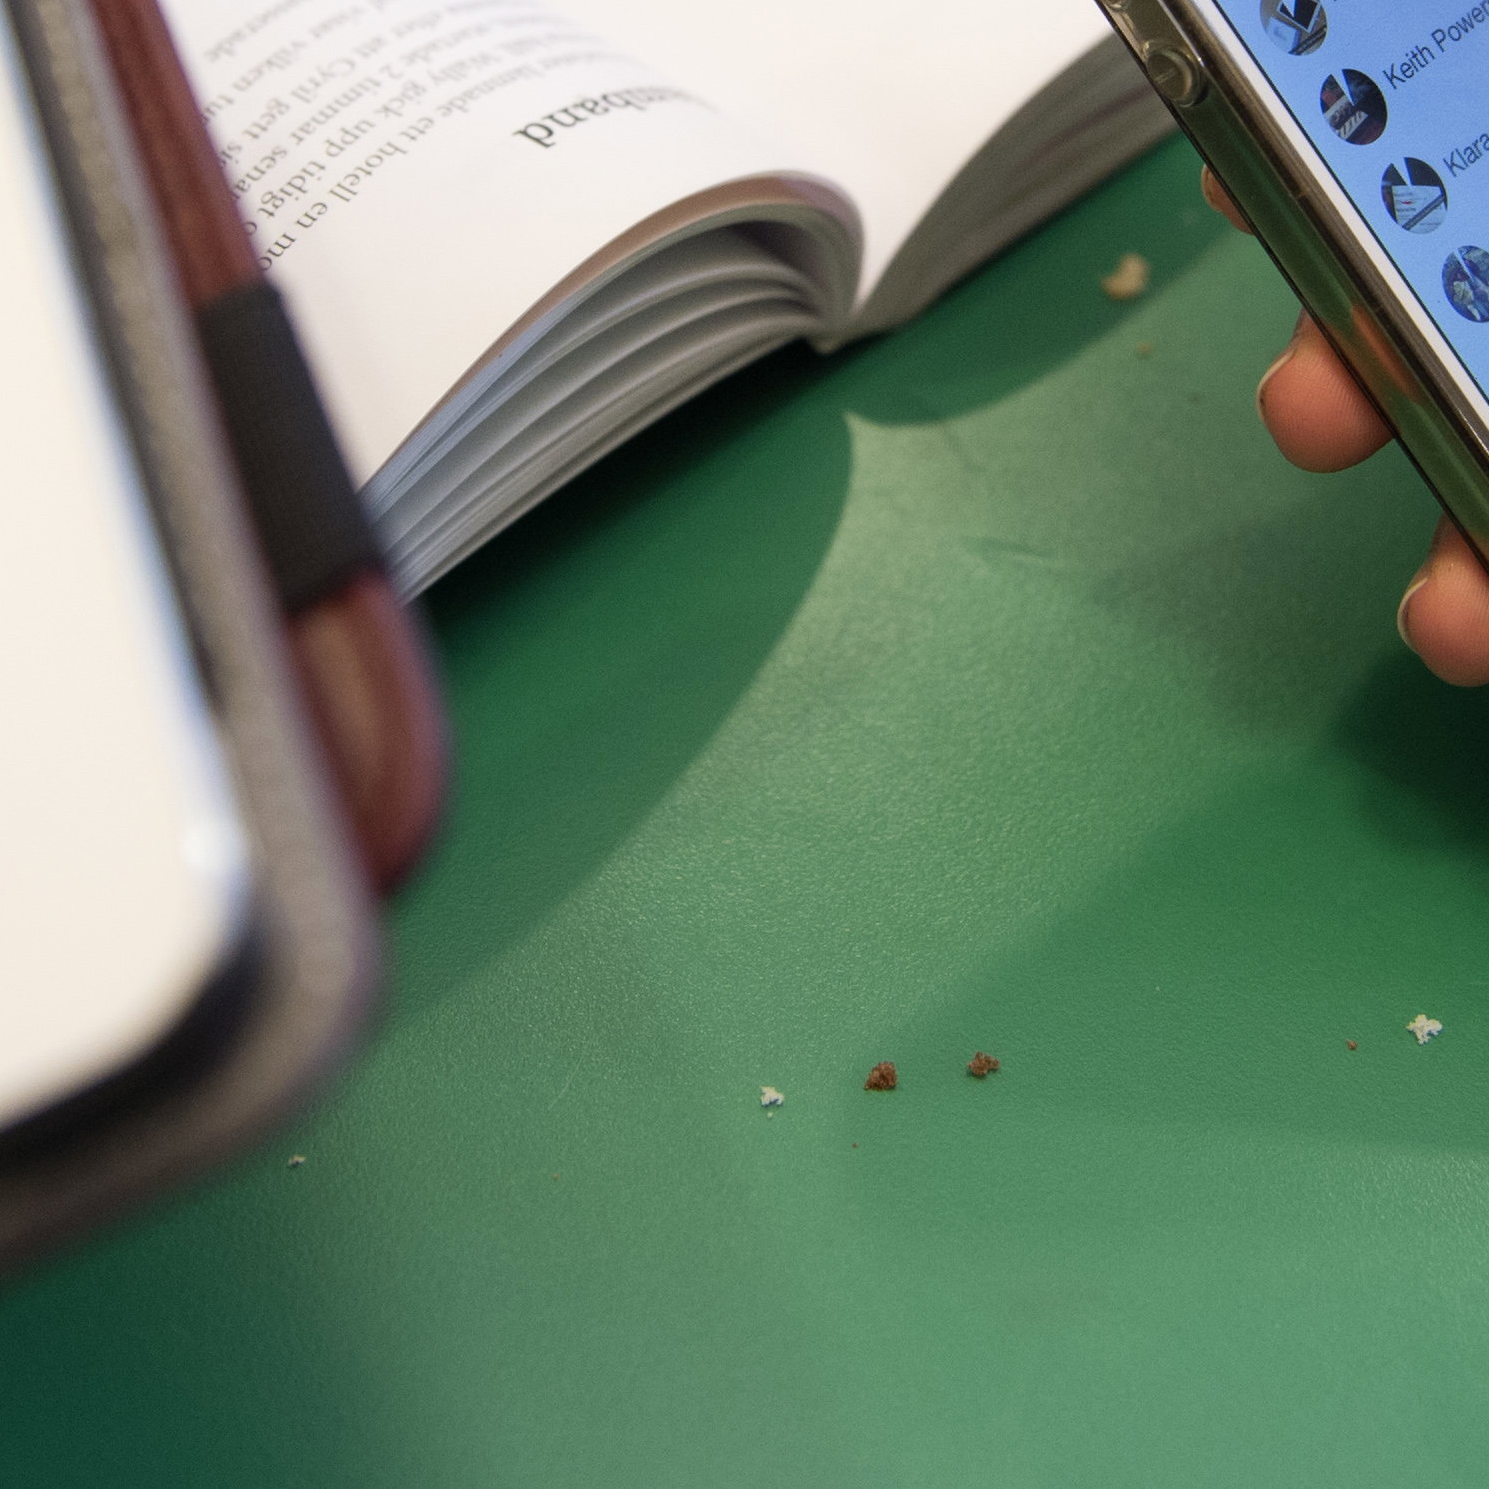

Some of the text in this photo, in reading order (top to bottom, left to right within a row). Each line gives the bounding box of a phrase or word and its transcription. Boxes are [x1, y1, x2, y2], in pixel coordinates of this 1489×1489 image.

[1382, 39, 1438, 91] Keith
[242, 96, 291, 140] gett
[289, 76, 382, 145] timmar
[399, 115, 435, 142] ett
[324, 118, 377, 159] upp
[258, 159, 327, 219] tidigt
[329, 141, 408, 203] hotell
[296, 201, 328, 229] en
